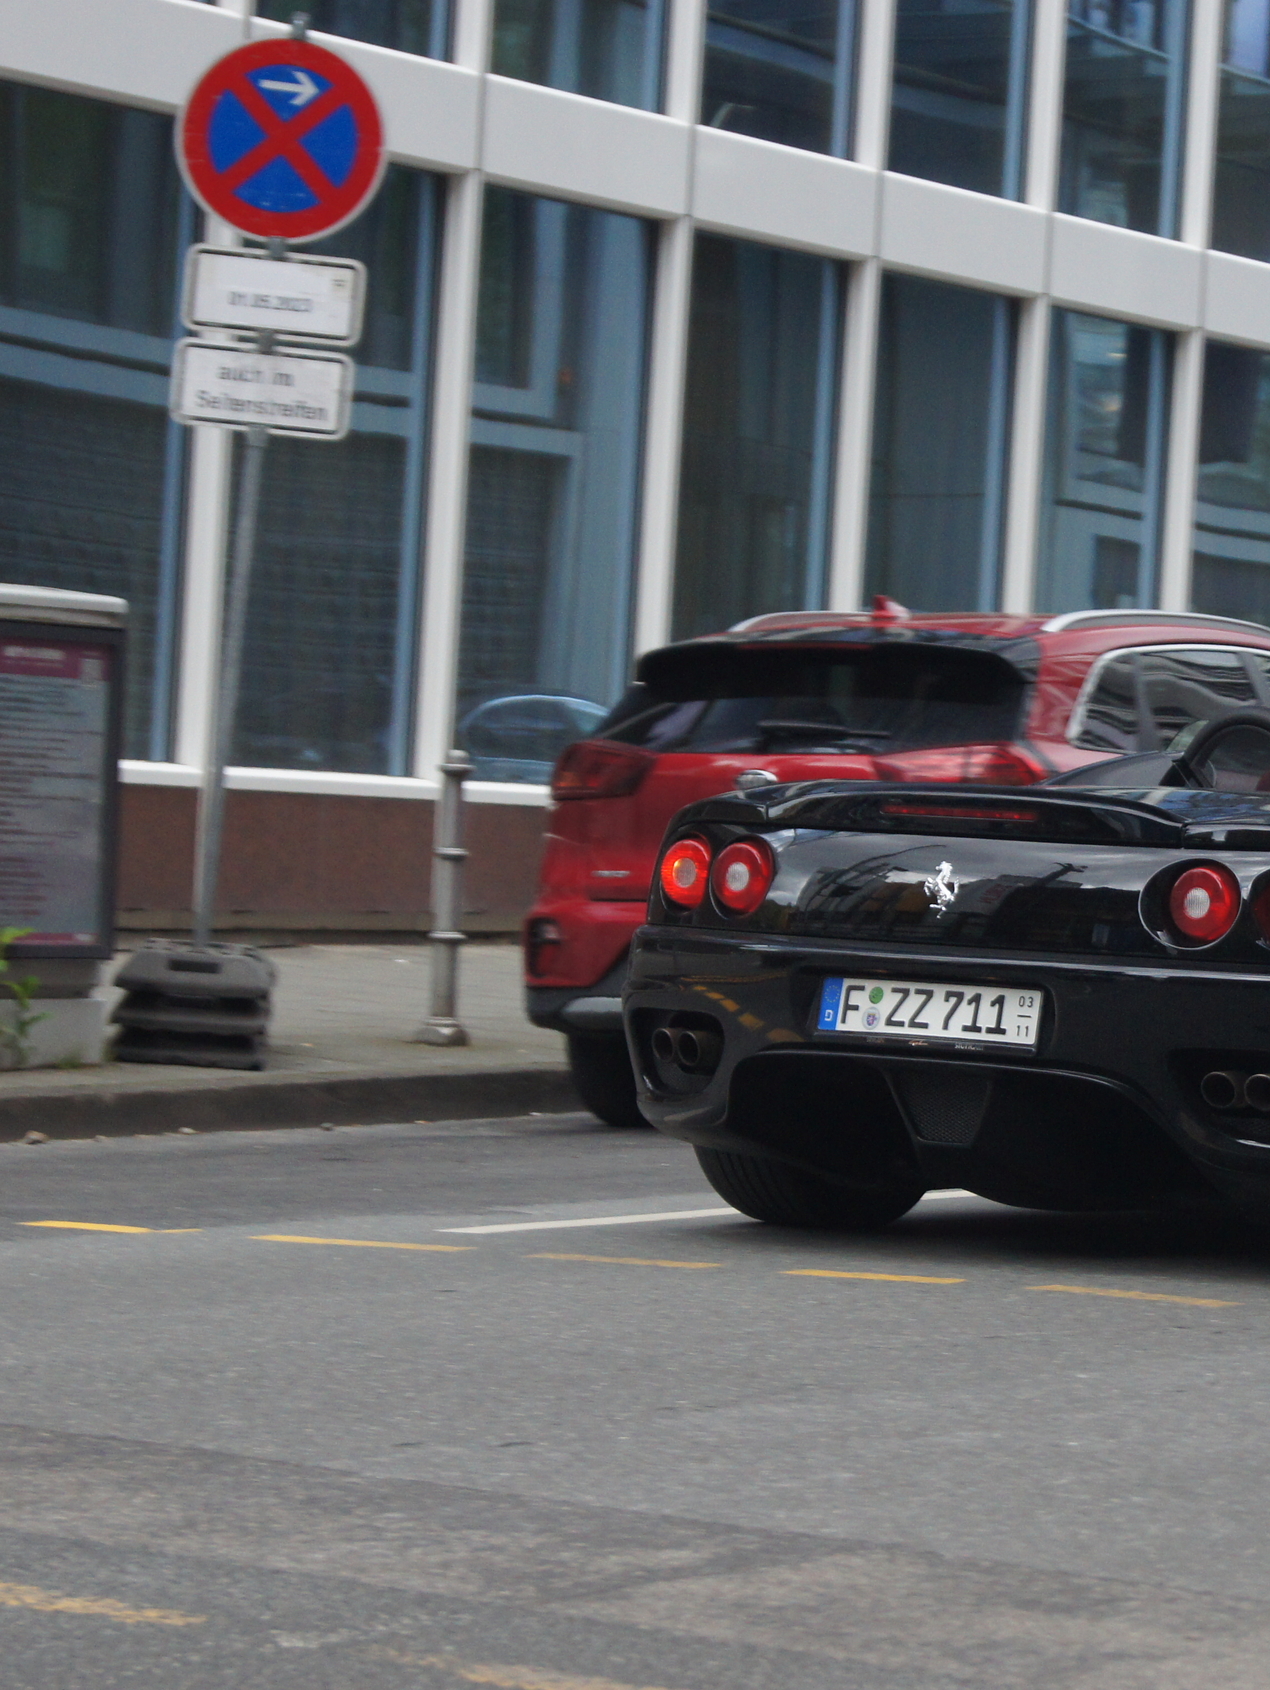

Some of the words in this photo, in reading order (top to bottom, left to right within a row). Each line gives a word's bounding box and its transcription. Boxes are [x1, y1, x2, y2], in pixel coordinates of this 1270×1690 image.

[1018, 995, 1034, 1008] 03
[824, 1009, 834, 1021] D
[840, 985, 865, 1024] F
[885, 987, 934, 1029] ZZ
[942, 990, 1007, 1035] 711
[1016, 1024, 1029, 1037] 11
